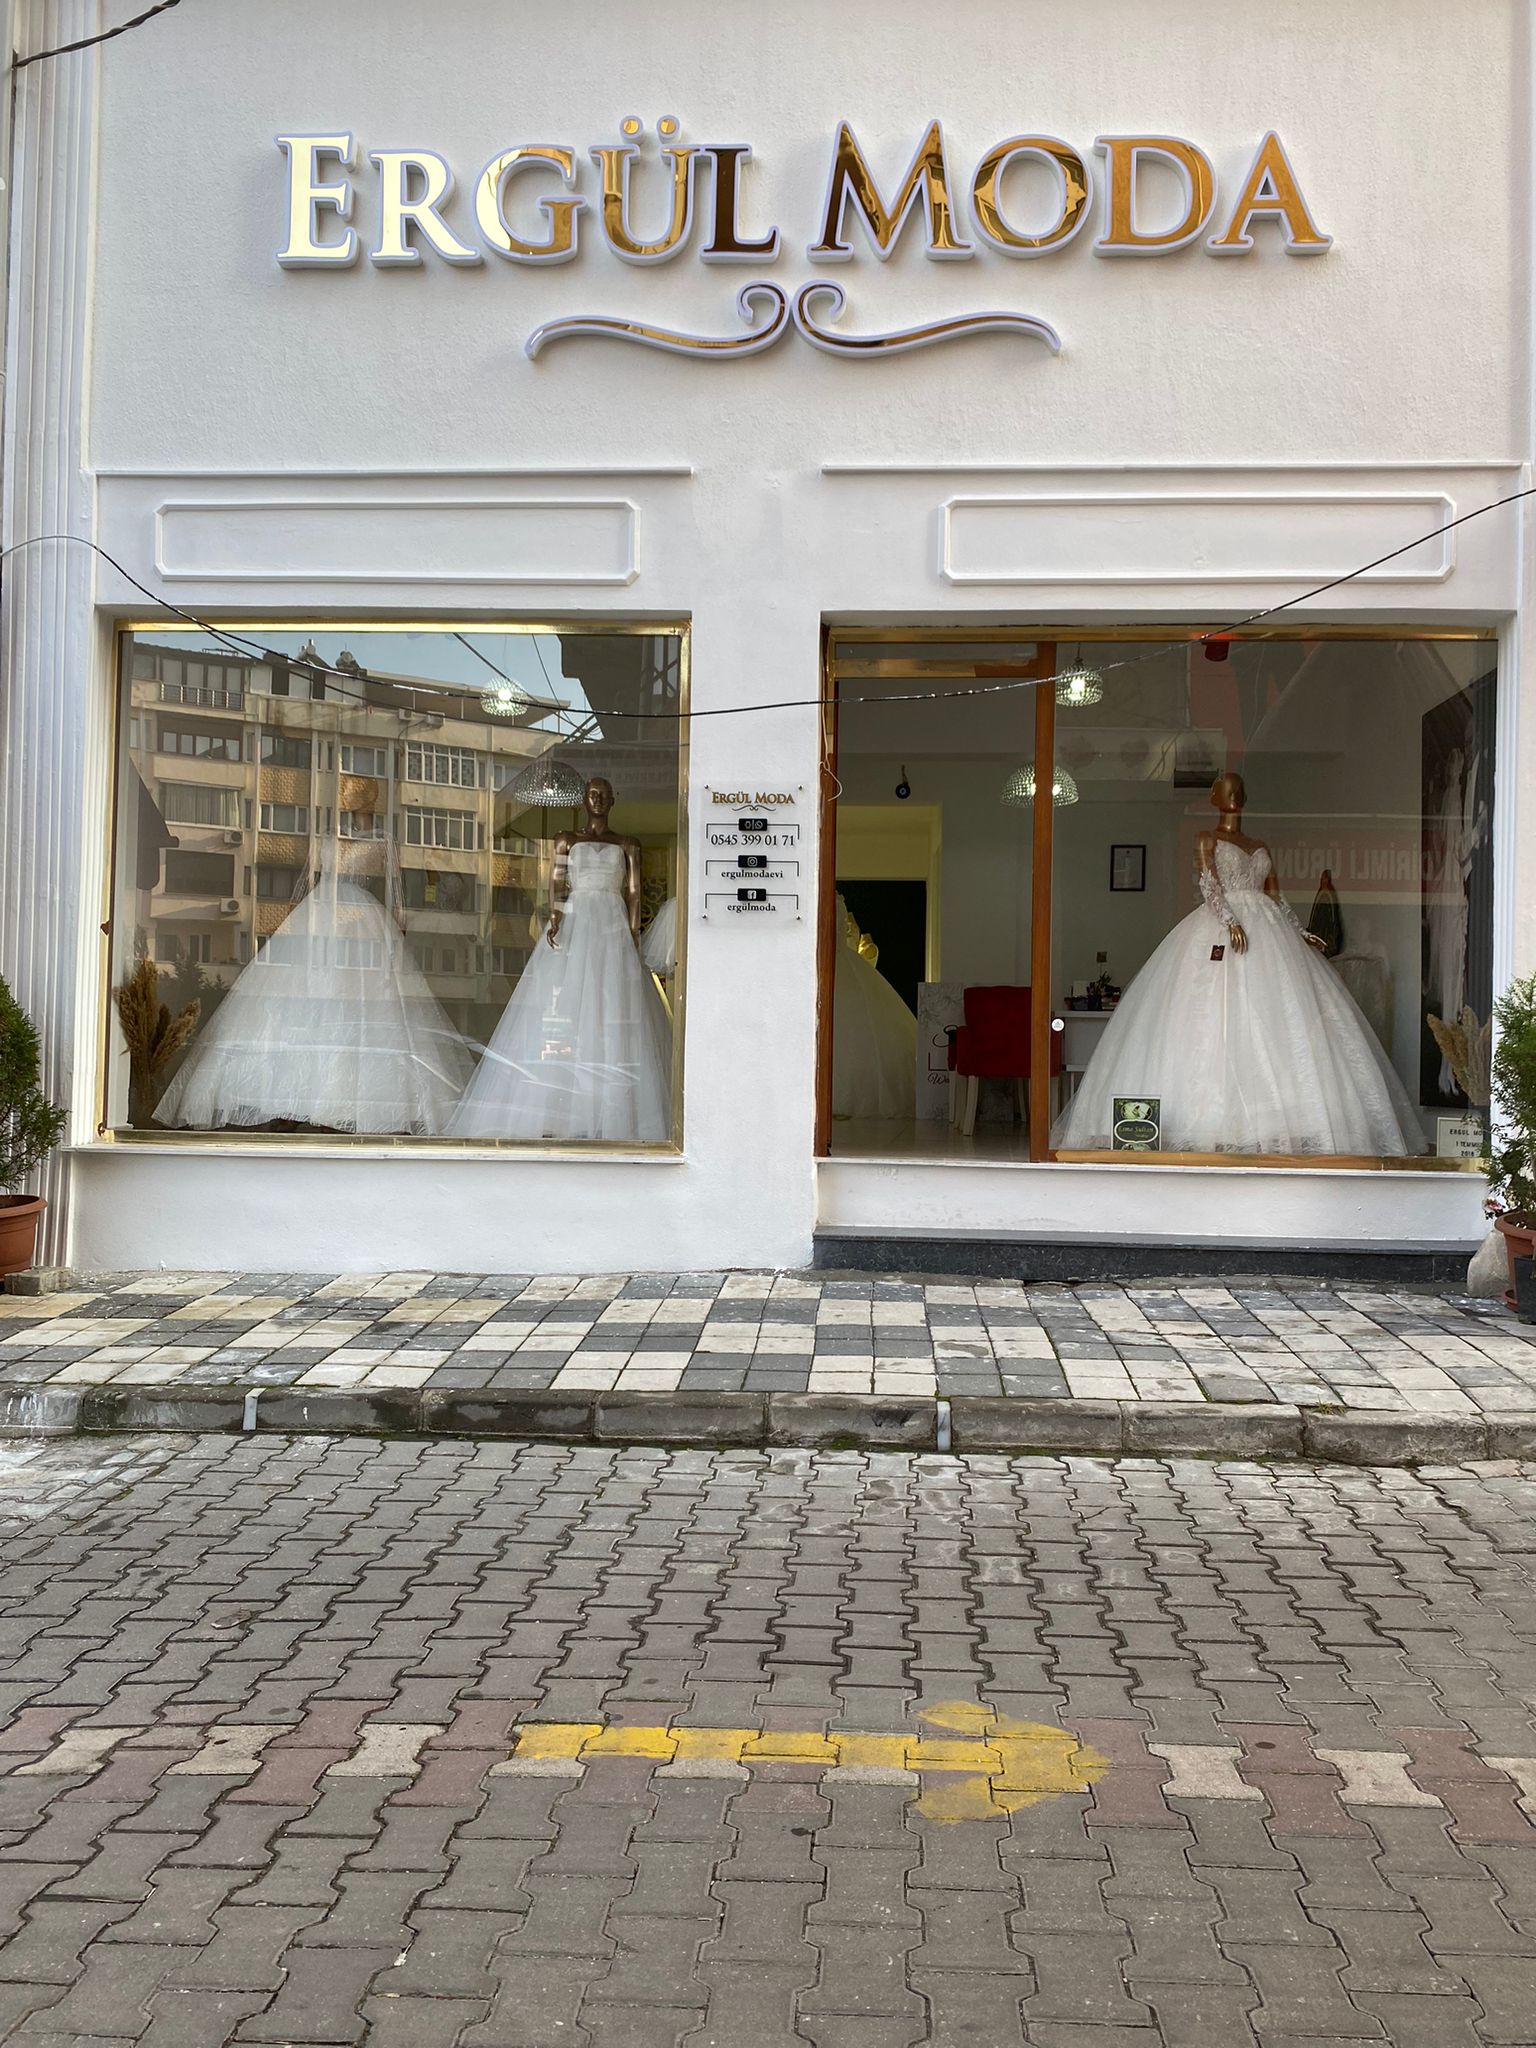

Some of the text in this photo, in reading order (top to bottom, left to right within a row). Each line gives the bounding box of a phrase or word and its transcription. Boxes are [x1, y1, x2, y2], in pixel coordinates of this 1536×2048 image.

[274, 115, 1334, 269] ERGÜL MODA
[711, 791, 795, 804] ERGÜL MODA
[711, 834, 794, 846] 0545 399 01 71
[721, 869, 783, 880] ergulmodaevi
[727, 902, 776, 913] ergülmoda
